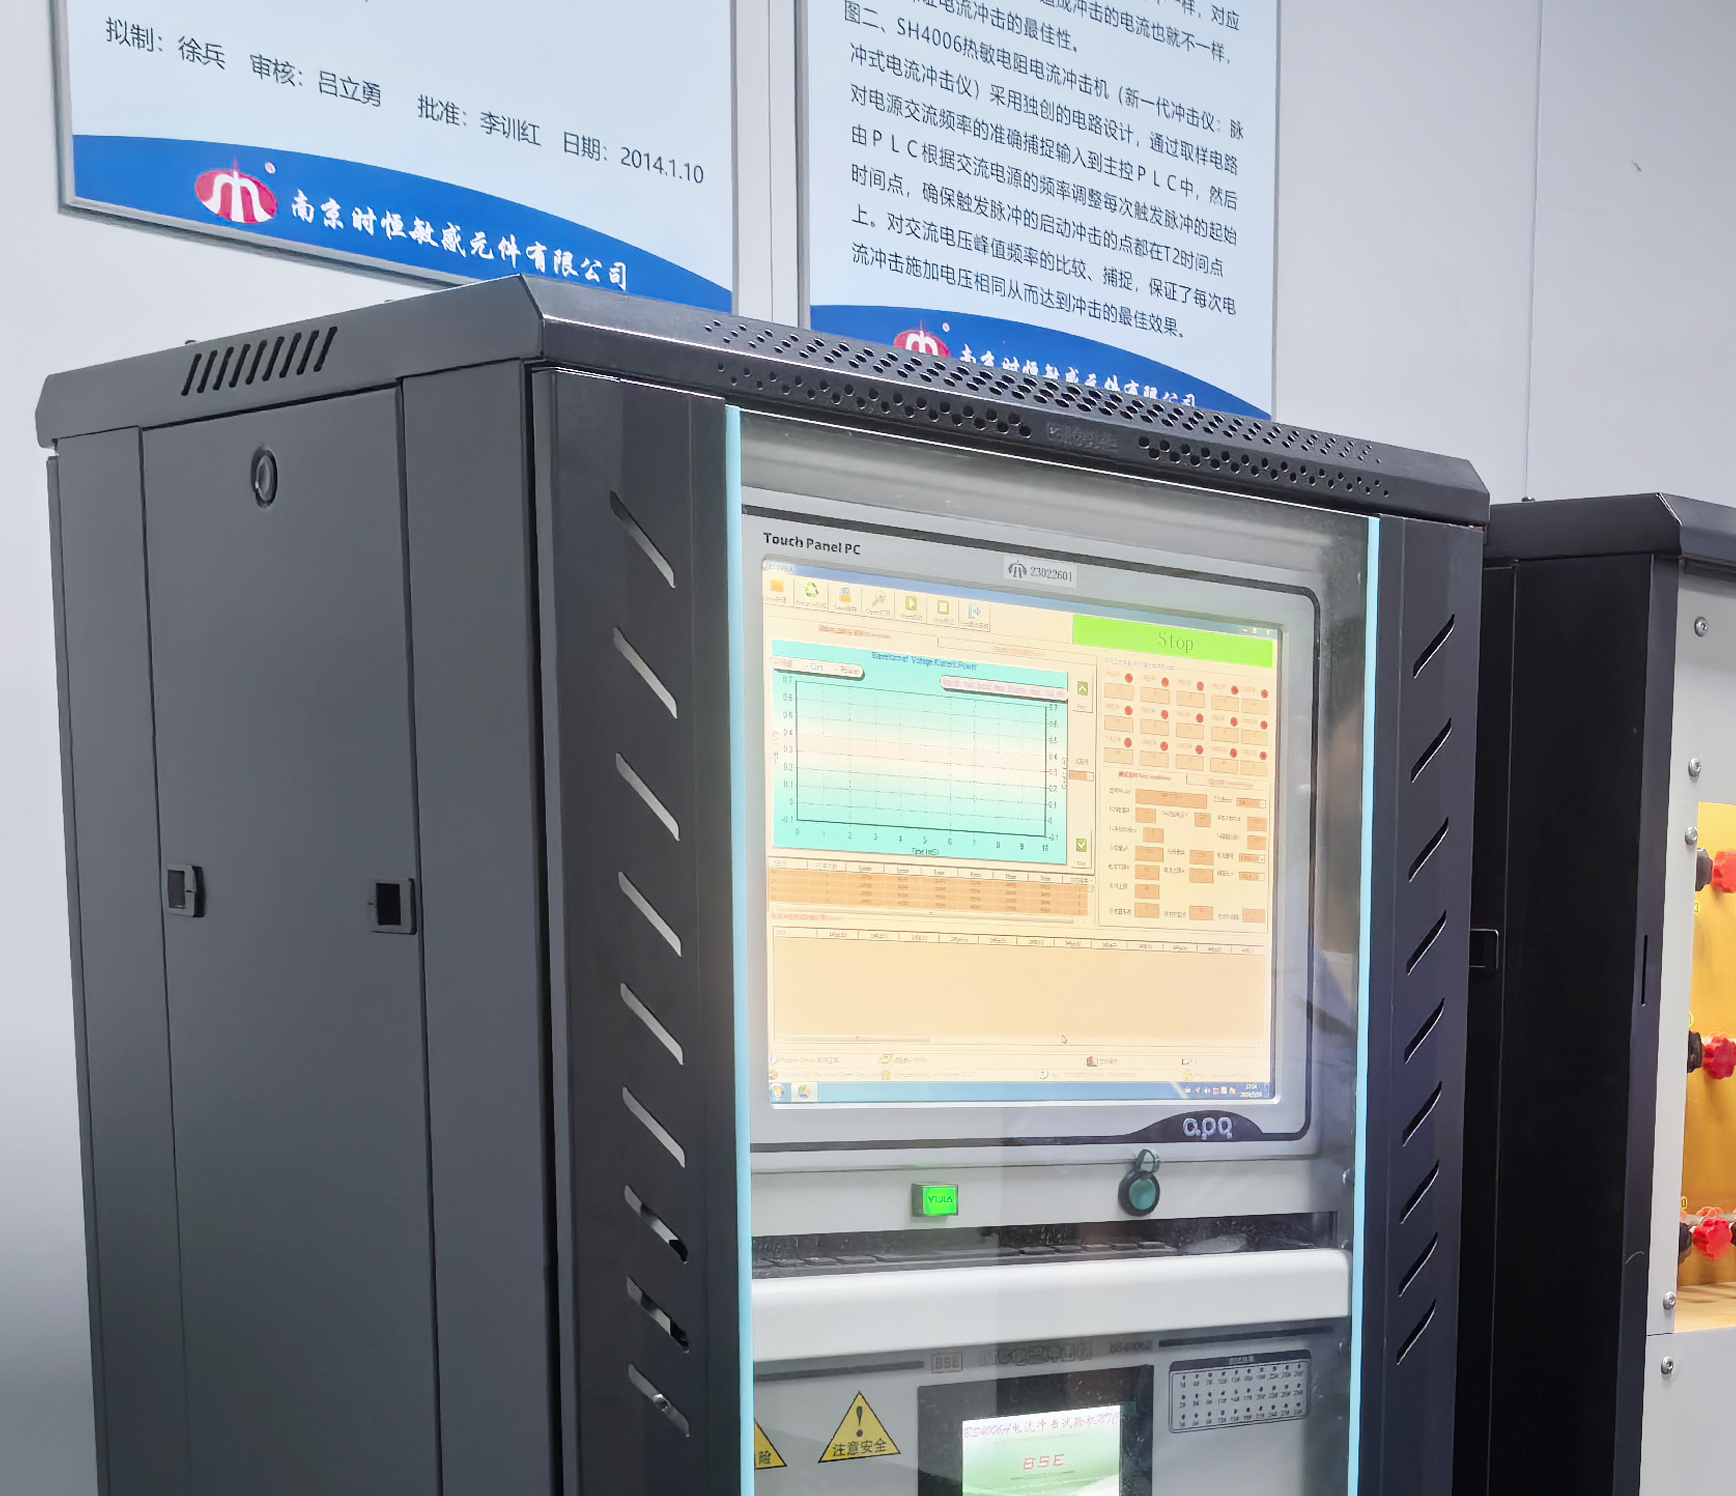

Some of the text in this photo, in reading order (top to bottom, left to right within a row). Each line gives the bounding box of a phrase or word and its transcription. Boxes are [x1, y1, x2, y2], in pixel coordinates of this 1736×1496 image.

[291, 189, 628, 292] 南京时恒敏感元件有限公司
[763, 532, 861, 555] Touch Panel PC
[1030, 566, 1072, 582] 23022601
[1158, 630, 1194, 653] Stop
[832, 1438, 887, 1457] 注意安全
[1023, 1453, 1065, 1470] BSE
